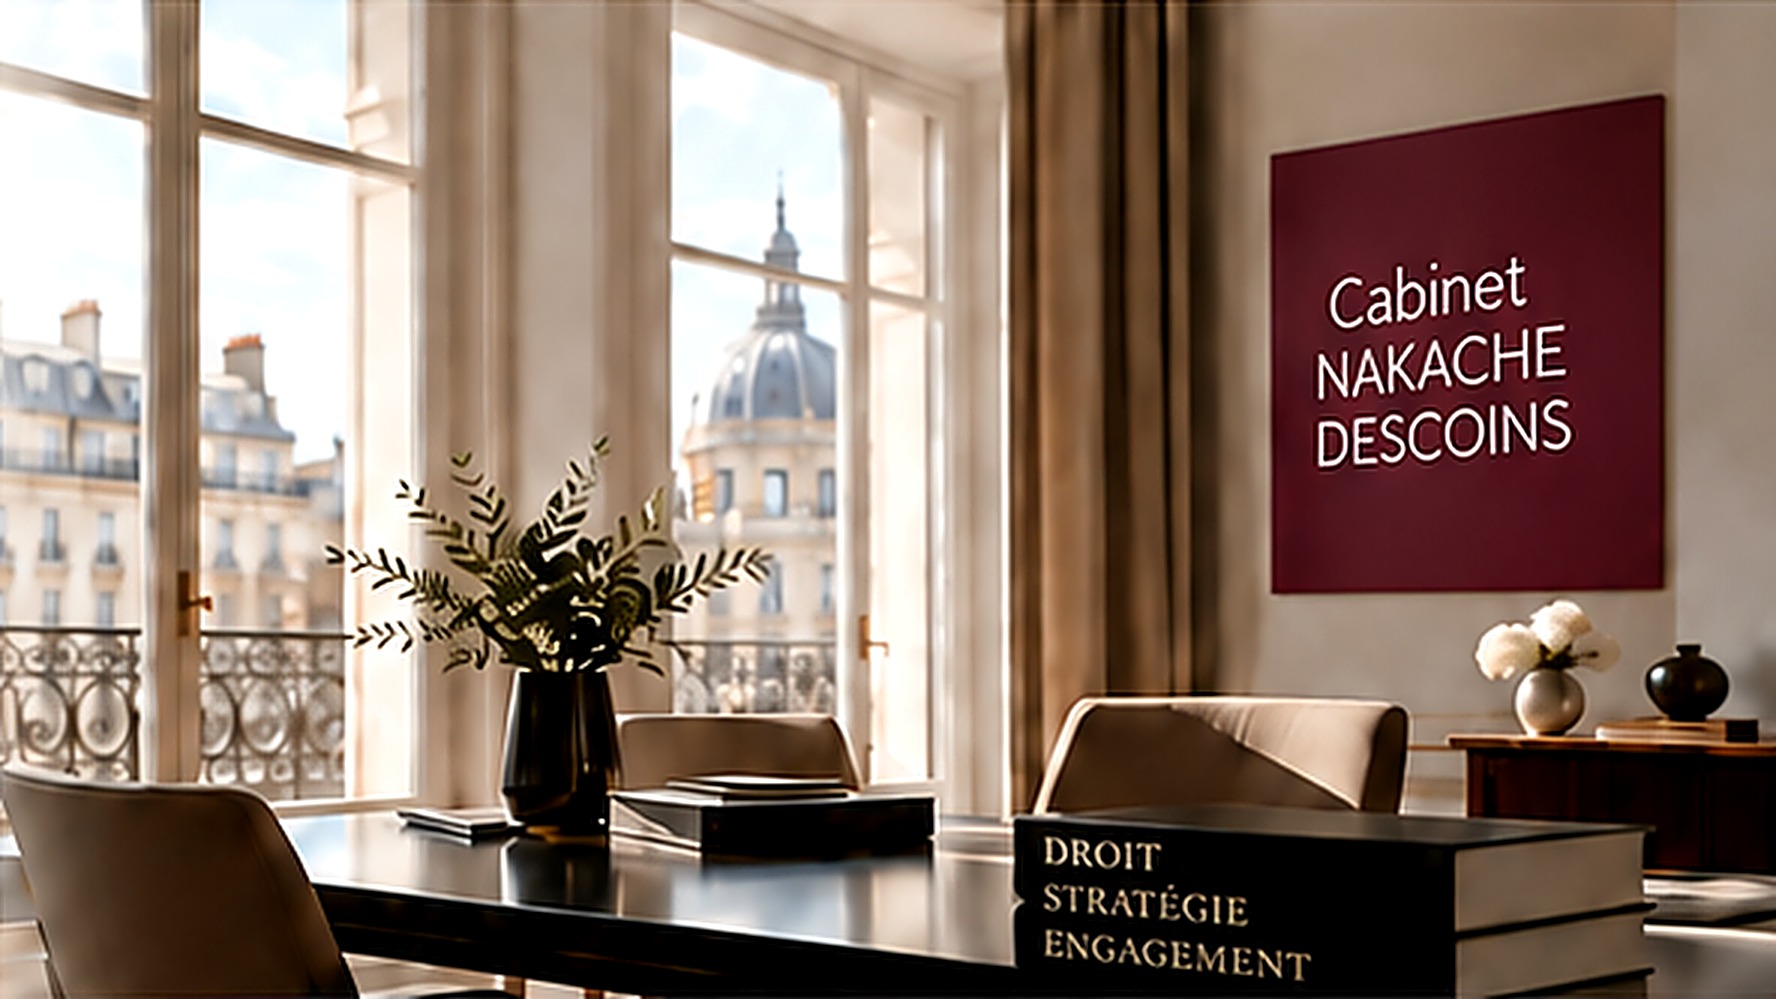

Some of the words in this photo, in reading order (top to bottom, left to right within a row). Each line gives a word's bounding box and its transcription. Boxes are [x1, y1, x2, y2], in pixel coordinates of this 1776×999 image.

[1330, 257, 1528, 329] Cabinet
[1318, 324, 1567, 400] NAKACHE
[1318, 399, 1572, 468] DESCOINS
[1044, 836, 1162, 871] DROIT
[1043, 883, 1249, 927] STRATÉGIE
[1045, 929, 1312, 981] ENGAGEMENT
